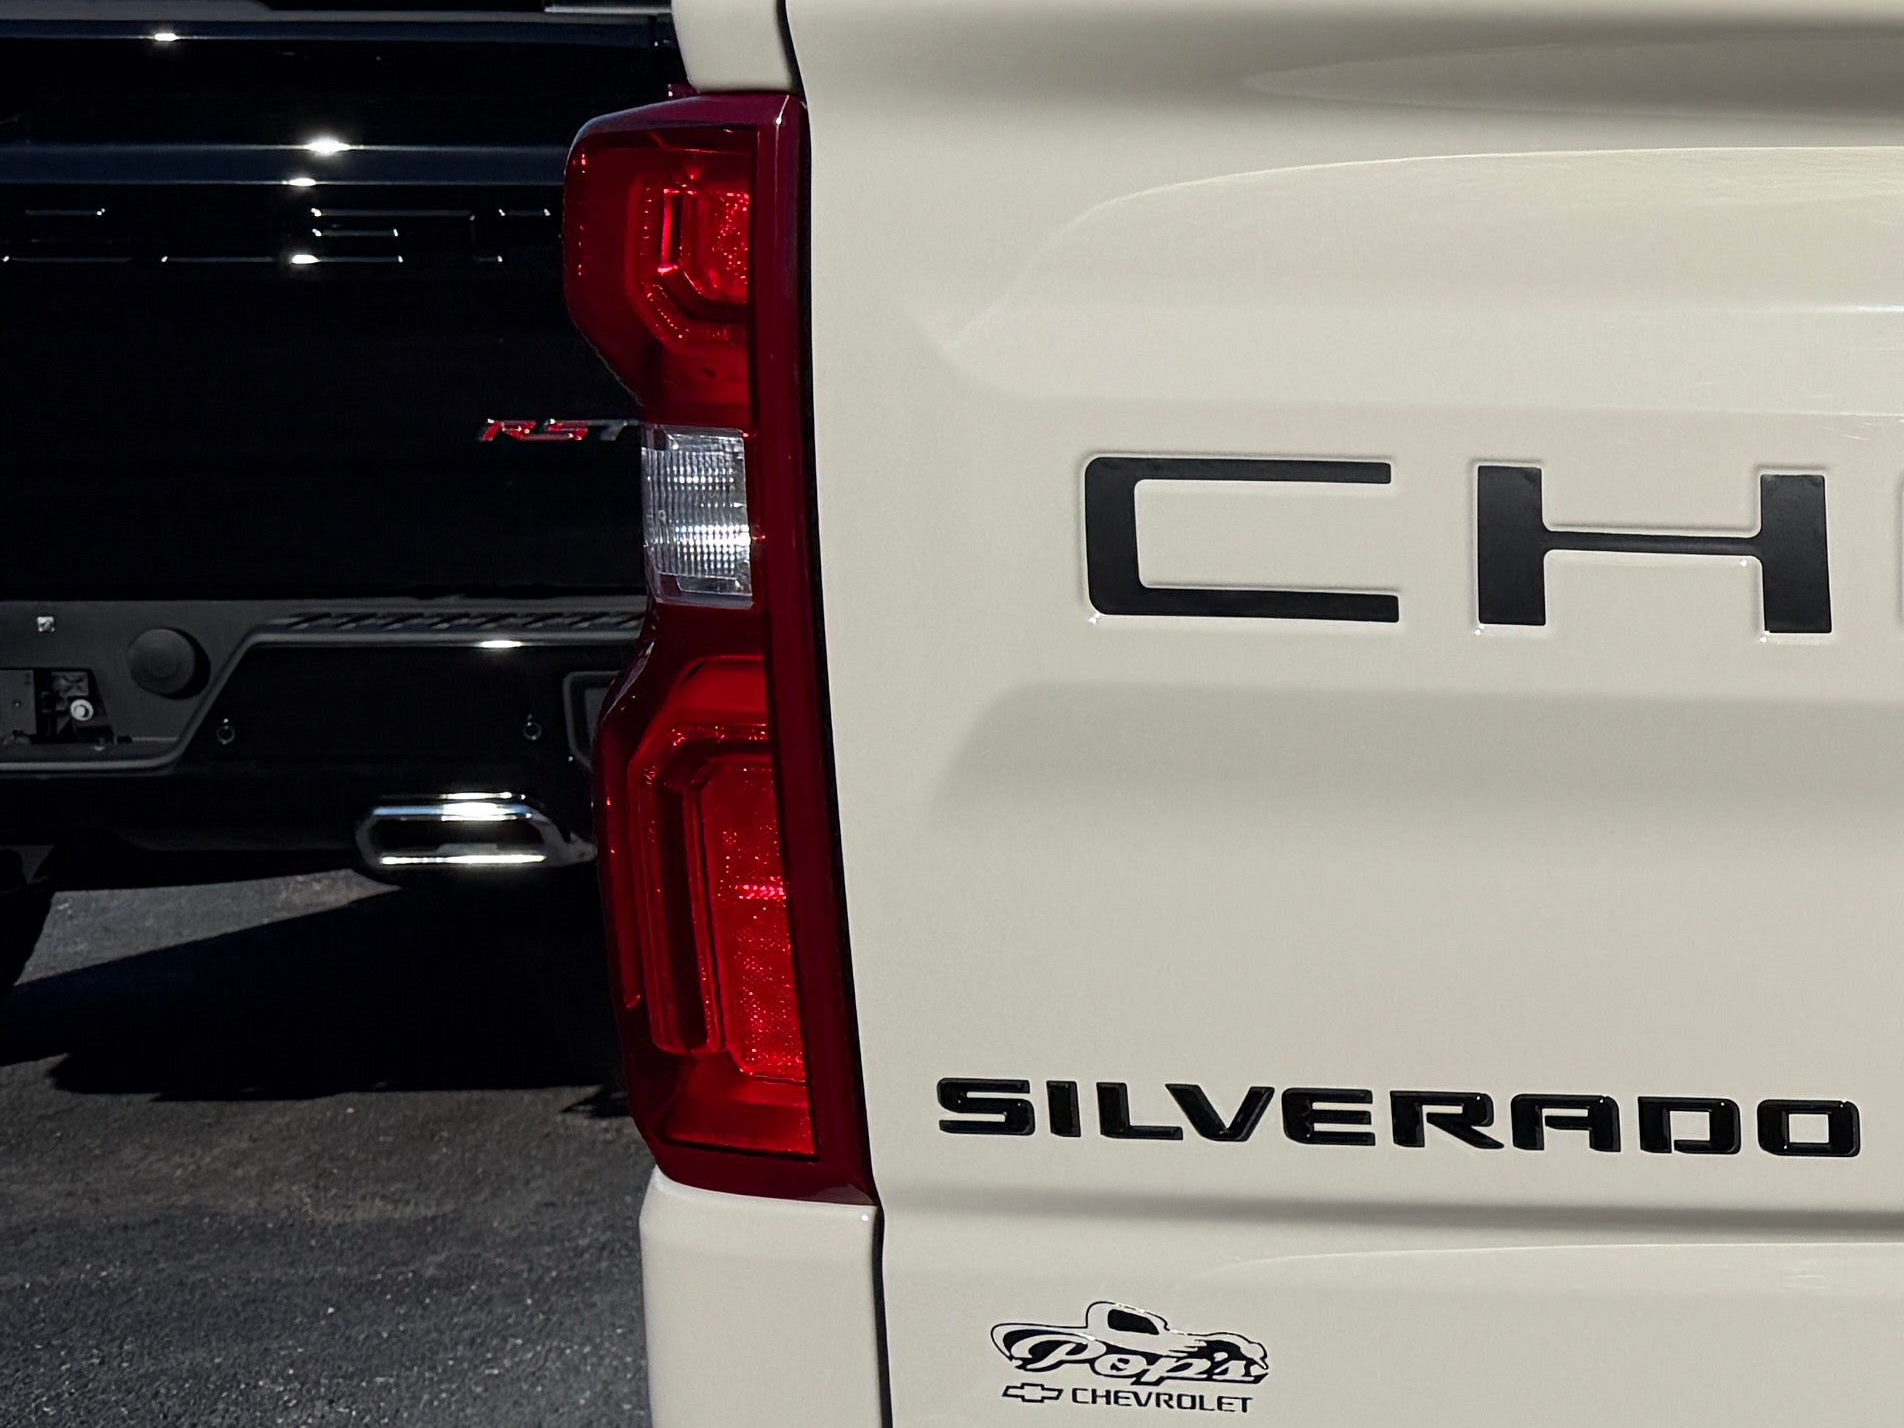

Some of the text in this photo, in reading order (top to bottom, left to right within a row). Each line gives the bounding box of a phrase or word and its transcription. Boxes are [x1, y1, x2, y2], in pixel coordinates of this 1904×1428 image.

[478, 418, 641, 442] RST
[936, 1076, 1862, 1159] SILVERADO
[1010, 1333, 1258, 1385] Pop's
[1071, 1387, 1253, 1413] CHEVROLET
